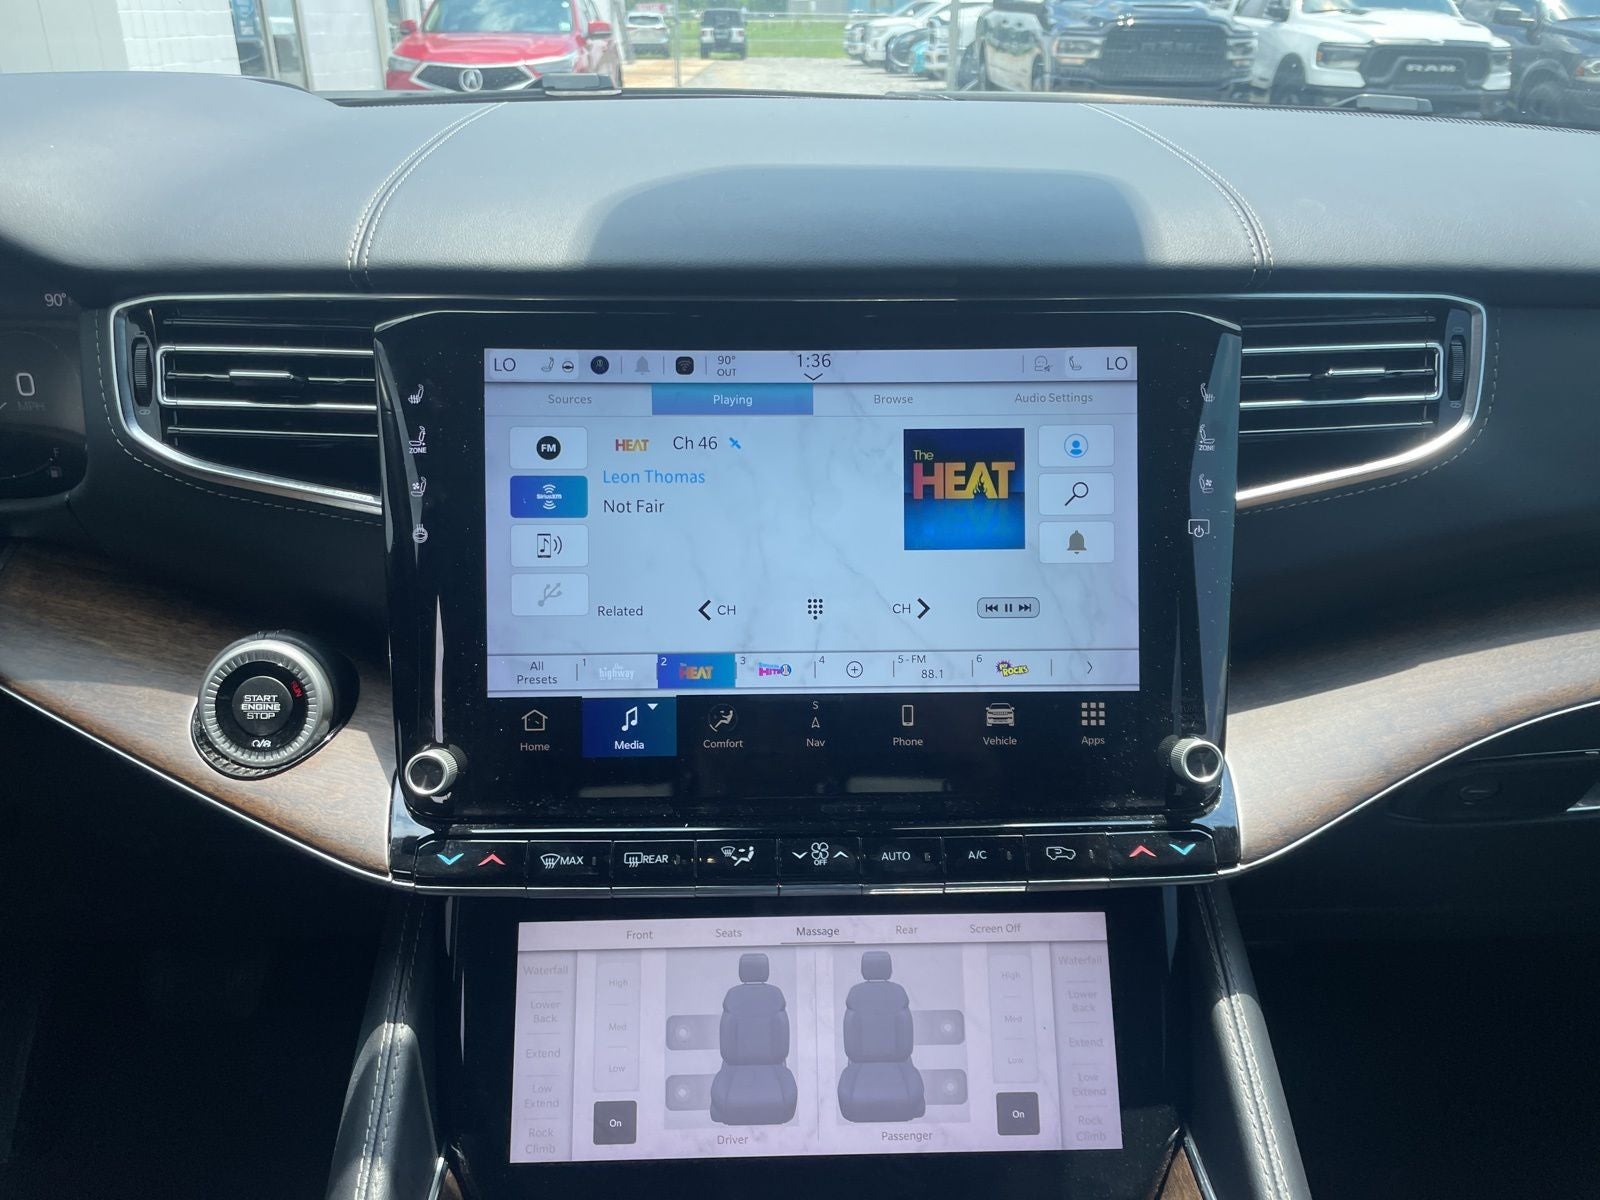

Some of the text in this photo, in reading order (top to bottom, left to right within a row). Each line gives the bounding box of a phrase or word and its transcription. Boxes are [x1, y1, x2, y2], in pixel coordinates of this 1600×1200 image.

[1406, 63, 1456, 72] RAM
[717, 355, 736, 365] 90°
[798, 354, 831, 367] 1:36
[1106, 356, 1127, 371] LO
[494, 358, 516, 372] LO
[717, 368, 736, 377] OUT
[17, 373, 35, 396] 0
[548, 394, 592, 404] Sources
[713, 394, 753, 406] Playing
[874, 394, 913, 404] Browse
[1015, 392, 1093, 405] Audio Settings
[615, 439, 649, 451] HEAT
[673, 436, 717, 450] Ch 46
[541, 444, 556, 452] FM
[913, 450, 933, 460] The
[603, 470, 705, 484] Leon Thomas
[913, 462, 1015, 499] HEAT
[603, 499, 664, 513] Not Fair
[598, 606, 643, 617] Related
[717, 605, 736, 615] CH
[892, 604, 911, 614] CH
[583, 658, 586, 666] 1
[661, 658, 667, 666] 2
[740, 657, 746, 665] 3
[819, 656, 825, 664] 4
[976, 655, 982, 663] 6
[530, 662, 543, 670] All
[600, 667, 634, 680] highway
[680, 667, 713, 679] HEAT
[921, 670, 943, 679] 88.1
[517, 675, 557, 685] Presets
[813, 700, 819, 710] S
[615, 740, 644, 750] Media
[703, 739, 743, 748] Comfort
[806, 738, 826, 747] Nav
[893, 737, 923, 746] Phone
[983, 737, 1017, 746] Vehicle
[1081, 737, 1105, 747] Apps
[520, 743, 549, 751] Home
[643, 854, 668, 864] REAR
[881, 852, 910, 861] AUTO
[968, 851, 986, 860] A/C
[560, 856, 583, 865] MAX
[796, 927, 840, 937] Massage
[896, 926, 918, 934] Rear
[970, 922, 1021, 934] Screen Off
[626, 930, 653, 940] Front
[716, 928, 742, 938] Seats
[1058, 956, 1102, 965] Waterfall
[523, 966, 568, 976] Waterfall
[609, 979, 628, 988] High
[1068, 990, 1097, 999] Lower
[531, 1000, 560, 1009] Lower
[1072, 1004, 1096, 1012] Back
[534, 1014, 558, 1023] Back
[609, 1023, 627, 1031] Med
[1069, 1038, 1103, 1047] Extend
[526, 1048, 560, 1058] Extend
[609, 1065, 625, 1073] Low
[533, 1085, 552, 1093] Low
[1072, 1087, 1106, 1097] Extend
[524, 1099, 559, 1108] Extend
[1012, 1110, 1024, 1118] On
[609, 1119, 621, 1127] On
[1078, 1116, 1102, 1125] Rock
[529, 1128, 553, 1137] Rock
[882, 1131, 932, 1142] Passenger
[1076, 1132, 1106, 1141] Climb
[717, 1136, 748, 1144] Driver
[526, 1144, 555, 1154] Climb
